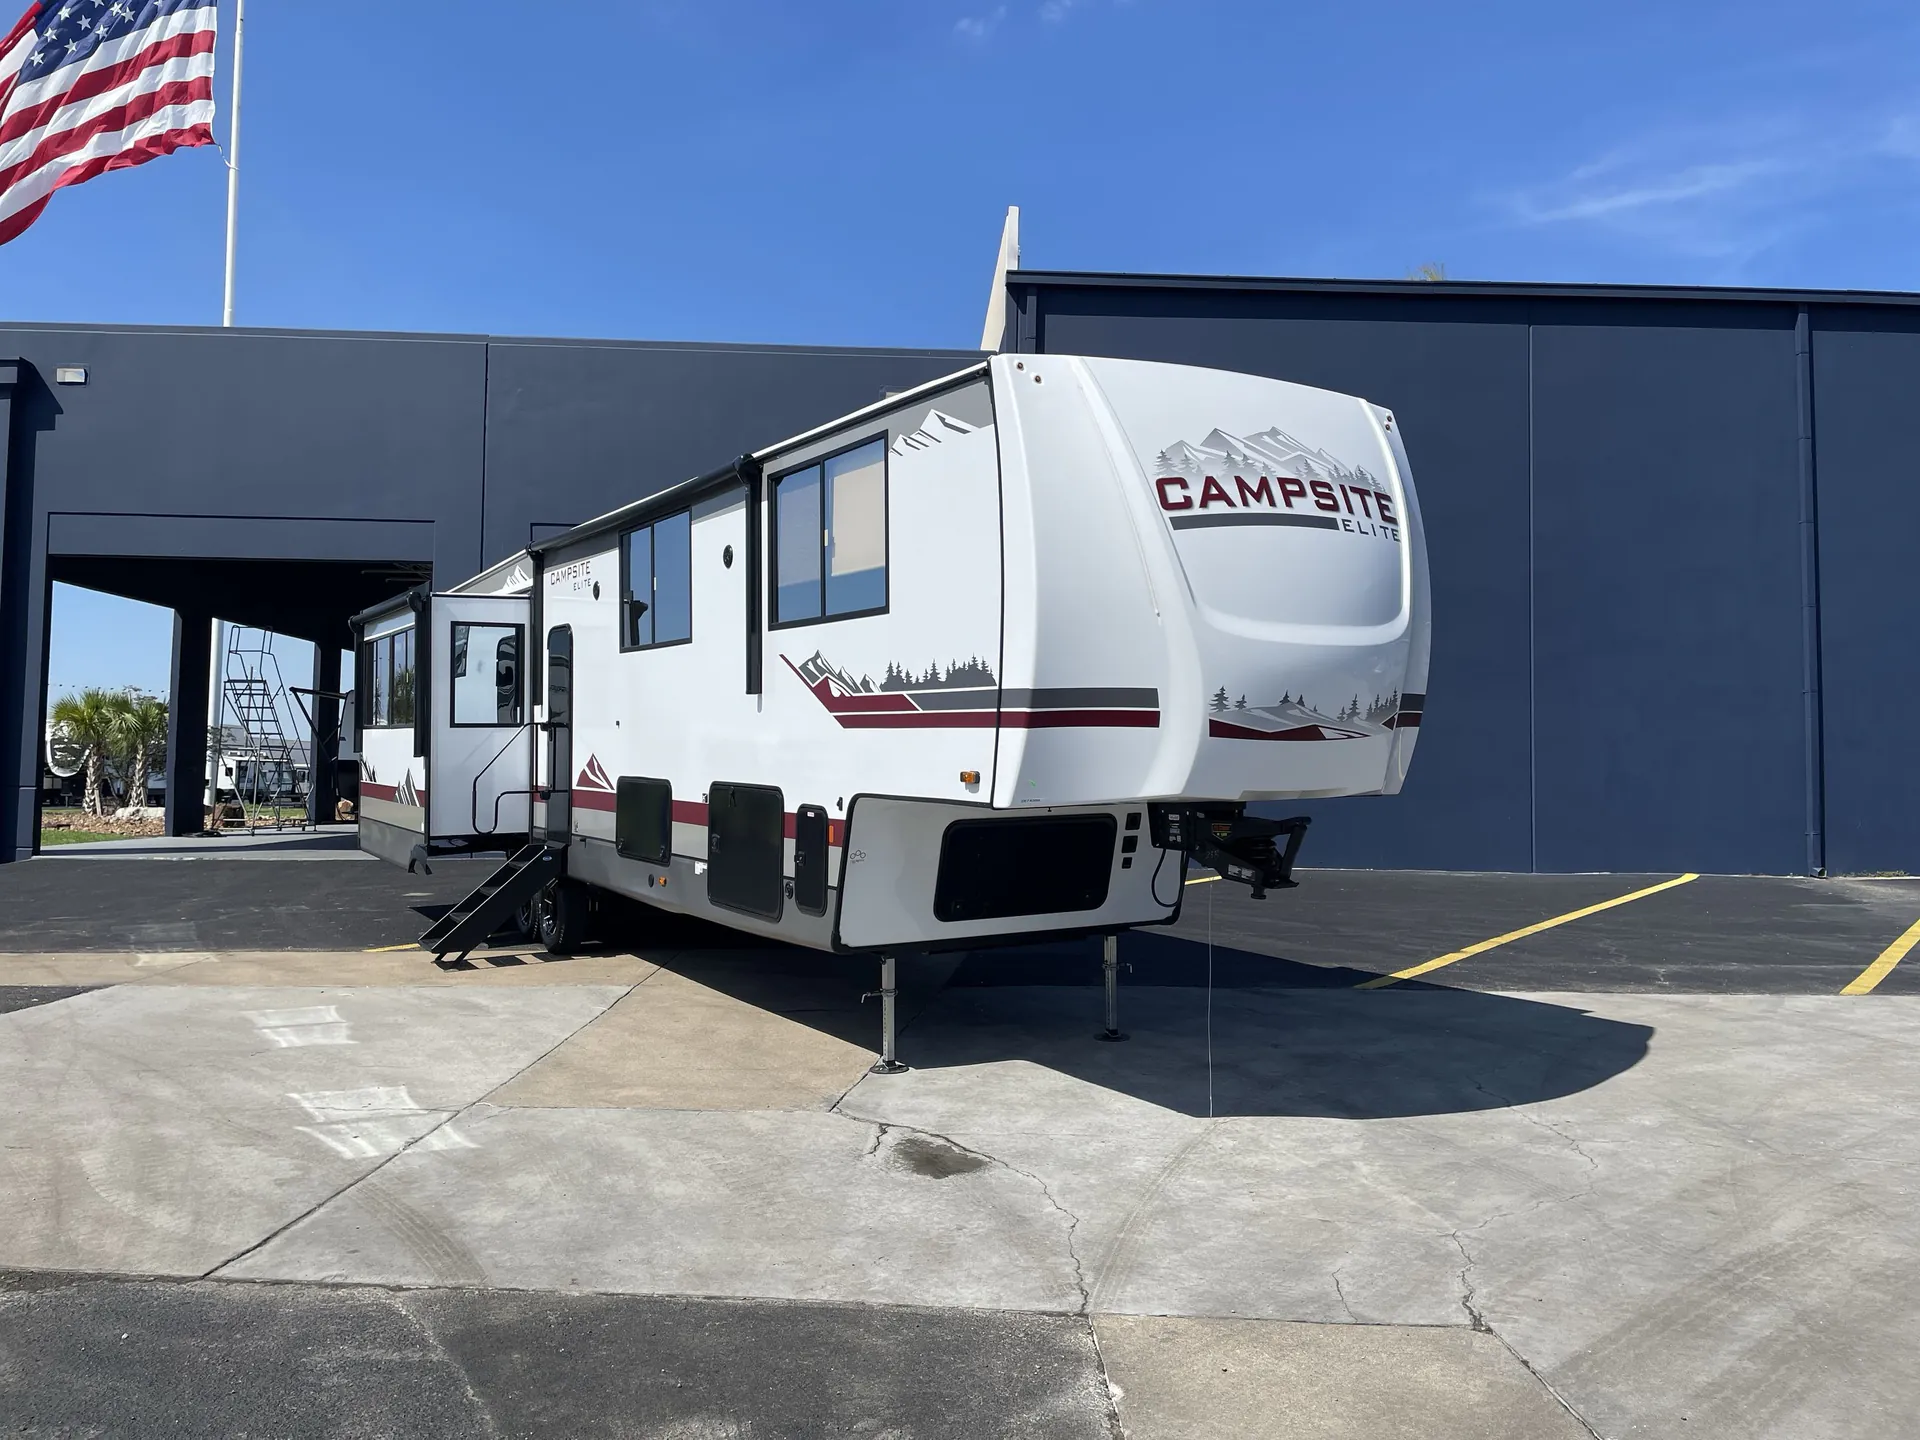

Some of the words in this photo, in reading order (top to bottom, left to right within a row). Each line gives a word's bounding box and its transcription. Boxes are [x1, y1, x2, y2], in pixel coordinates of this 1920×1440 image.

[1155, 474, 1398, 526] CAMPSITE
[1341, 518, 1401, 543] ELITE
[550, 560, 591, 586] CAMPSITE
[573, 578, 591, 591] ELITE
